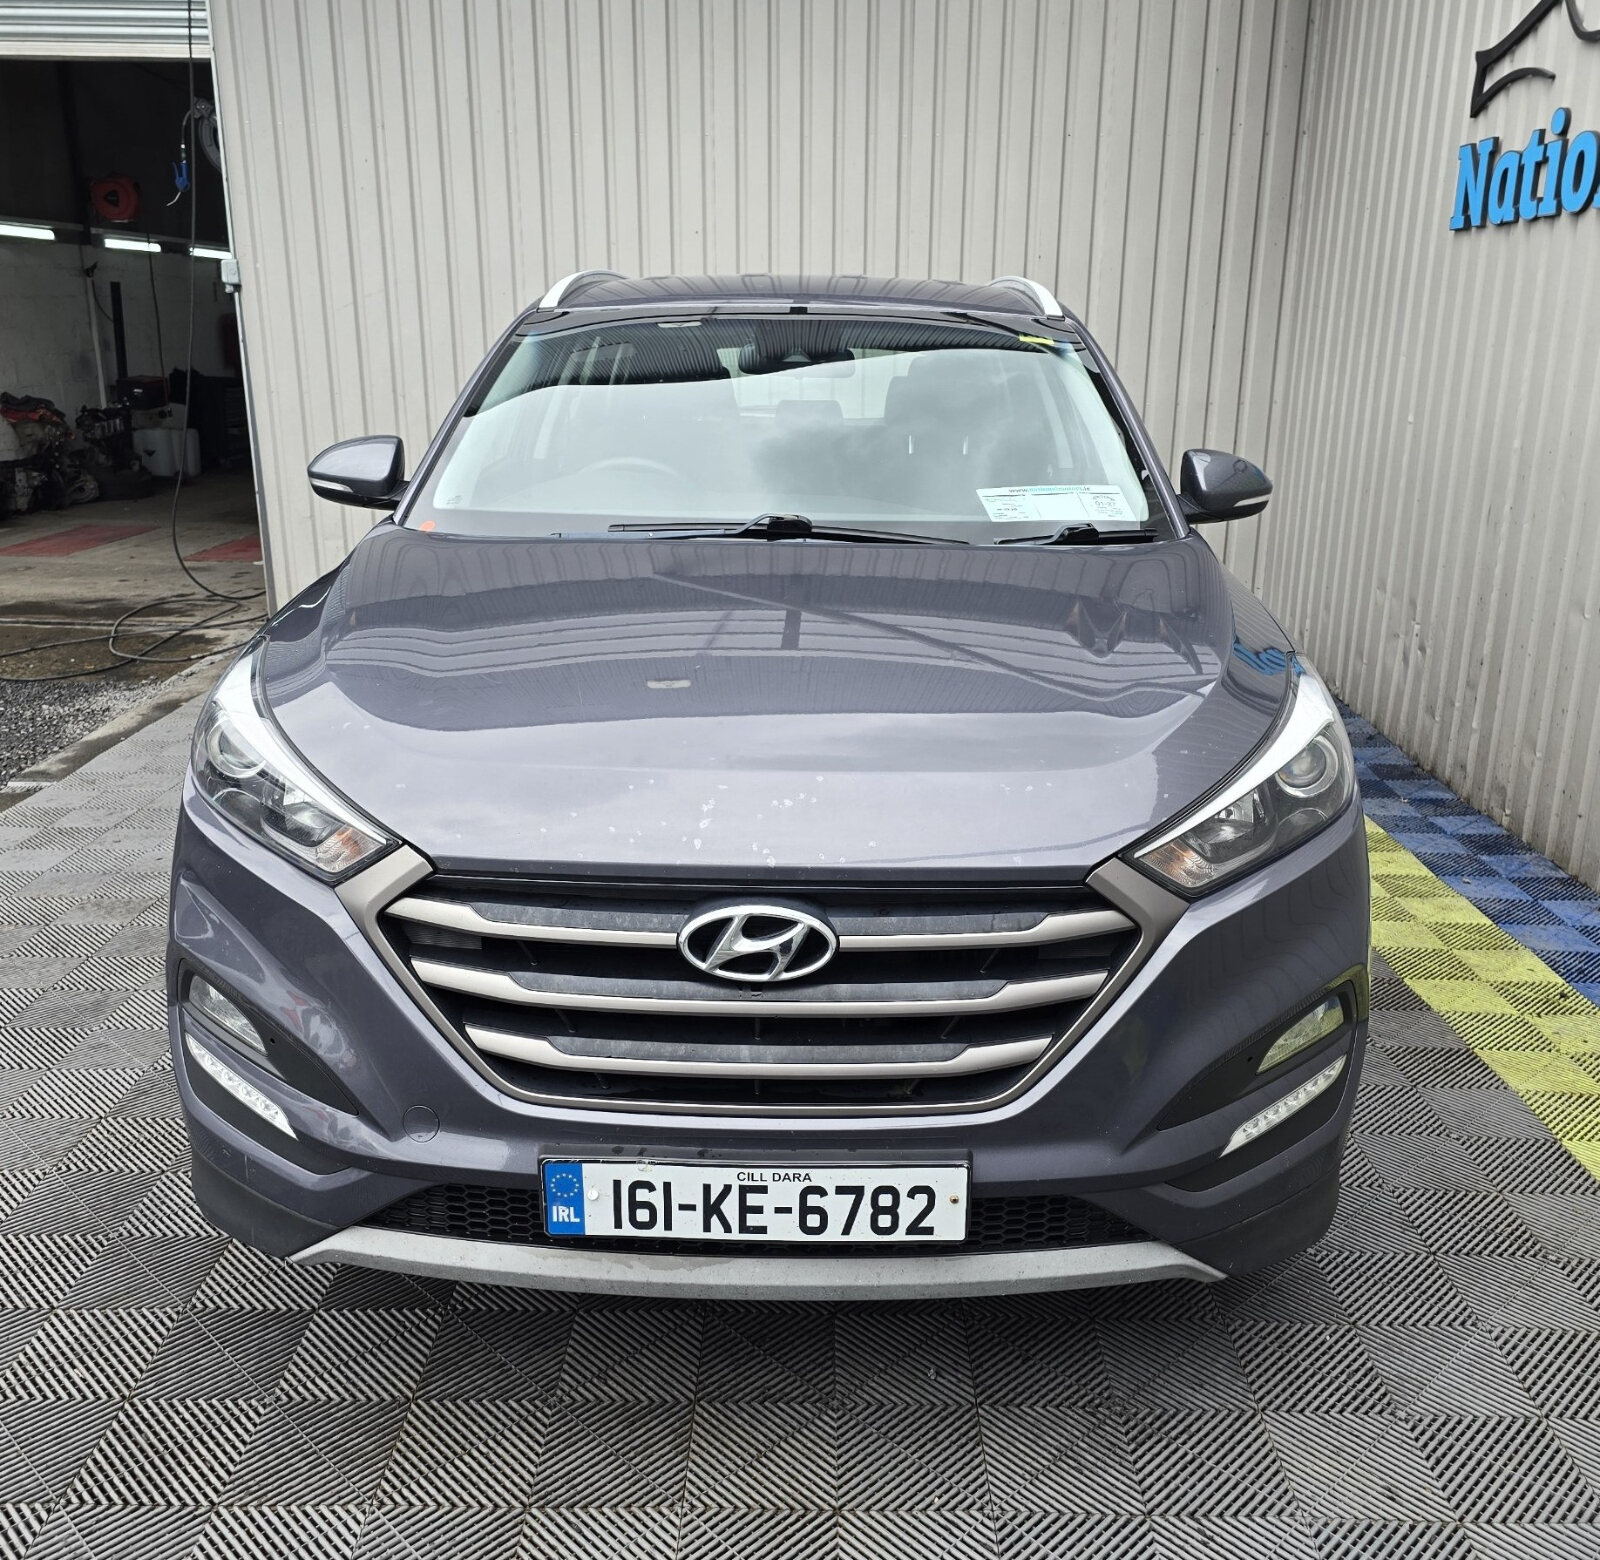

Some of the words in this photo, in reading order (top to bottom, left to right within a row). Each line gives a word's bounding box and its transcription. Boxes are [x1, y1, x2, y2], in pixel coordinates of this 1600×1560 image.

[1449, 107, 1600, 231] Natio
[736, 1171, 768, 1182] CILL
[772, 1172, 813, 1183] DARA
[552, 1205, 580, 1223] IRL
[612, 1179, 936, 1236] 161-KE-6782
